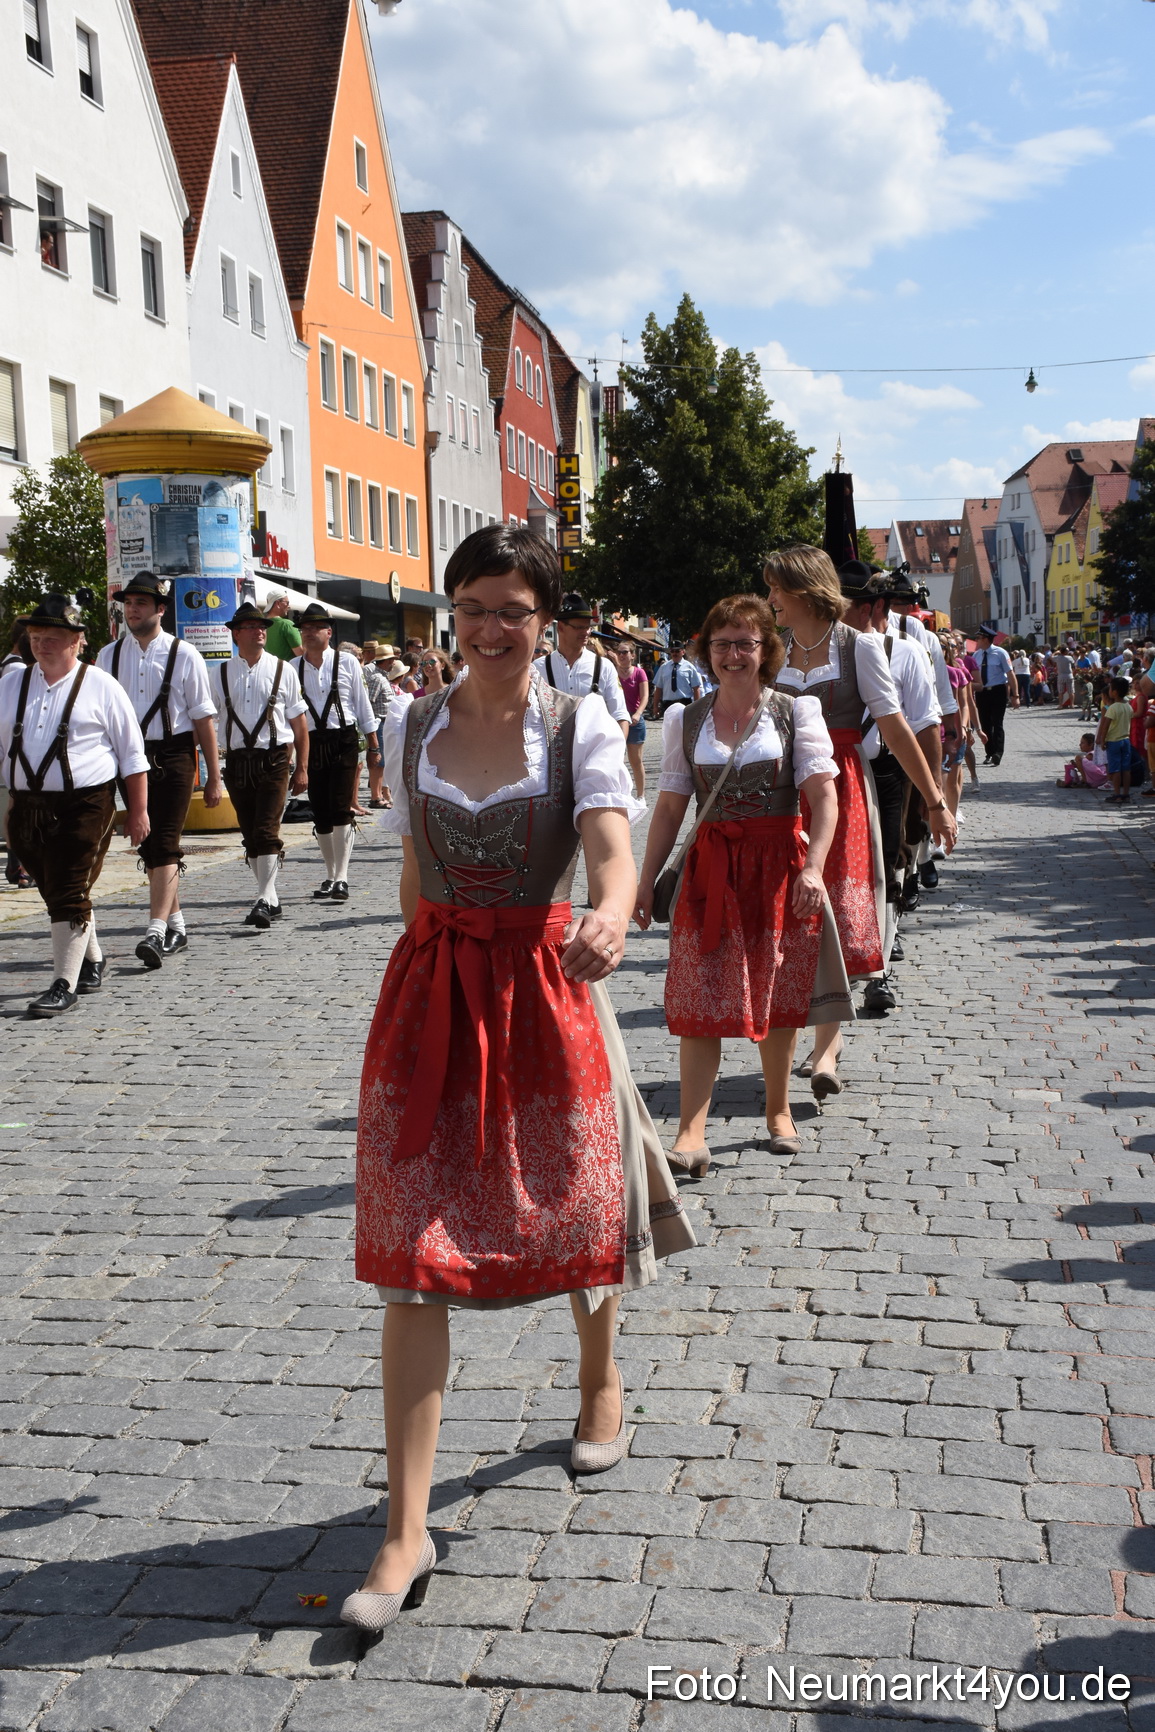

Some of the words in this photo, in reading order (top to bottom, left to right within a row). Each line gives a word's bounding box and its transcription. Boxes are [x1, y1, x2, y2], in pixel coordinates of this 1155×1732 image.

[168, 485, 202, 494] CHRISTIAN
[168, 495, 200, 504] SPRINGER
[560, 457, 579, 571] HOTEL
[184, 590, 221, 610] G6
